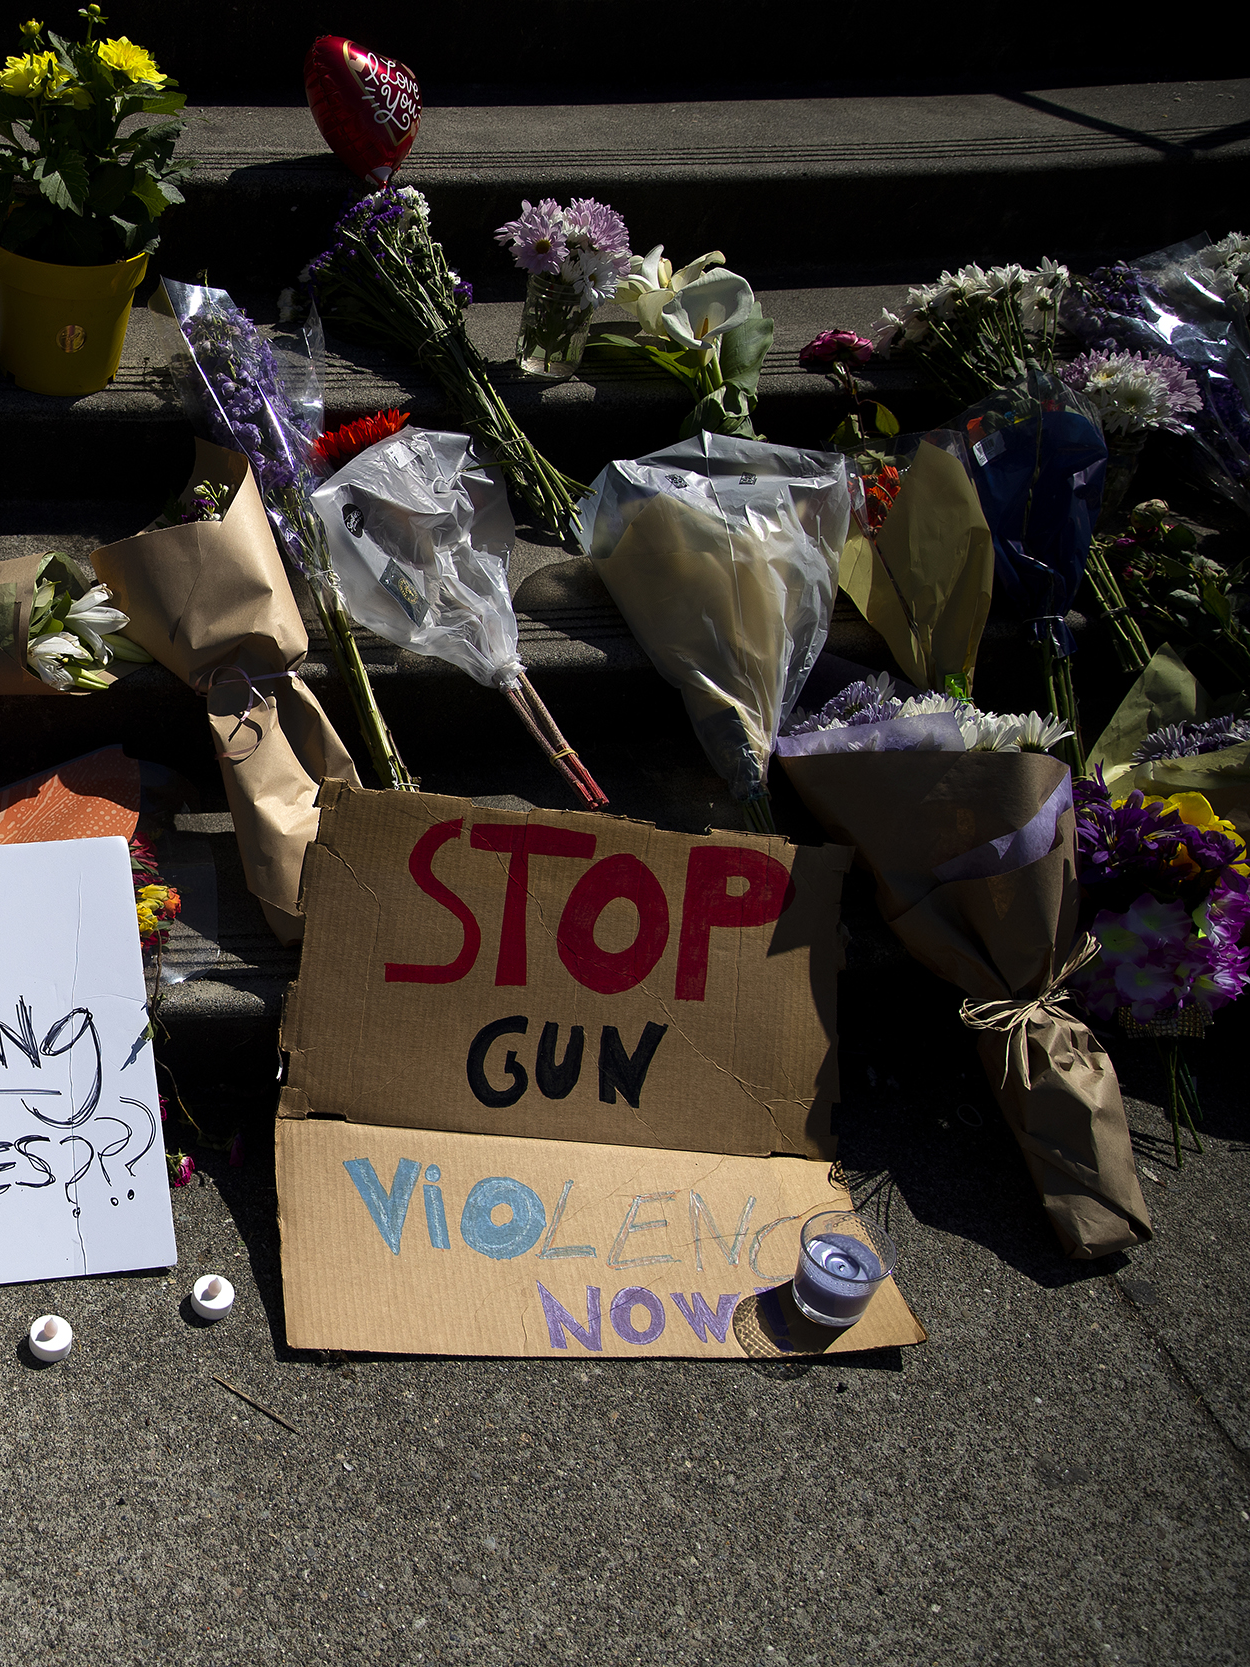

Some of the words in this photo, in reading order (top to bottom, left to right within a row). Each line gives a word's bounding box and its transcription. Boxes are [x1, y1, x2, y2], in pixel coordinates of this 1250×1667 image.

[365, 52, 379, 85] I
[380, 57, 420, 100] Love
[374, 84, 417, 131] You
[384, 816, 797, 1002] STOP
[466, 1015, 669, 1108] GUN
